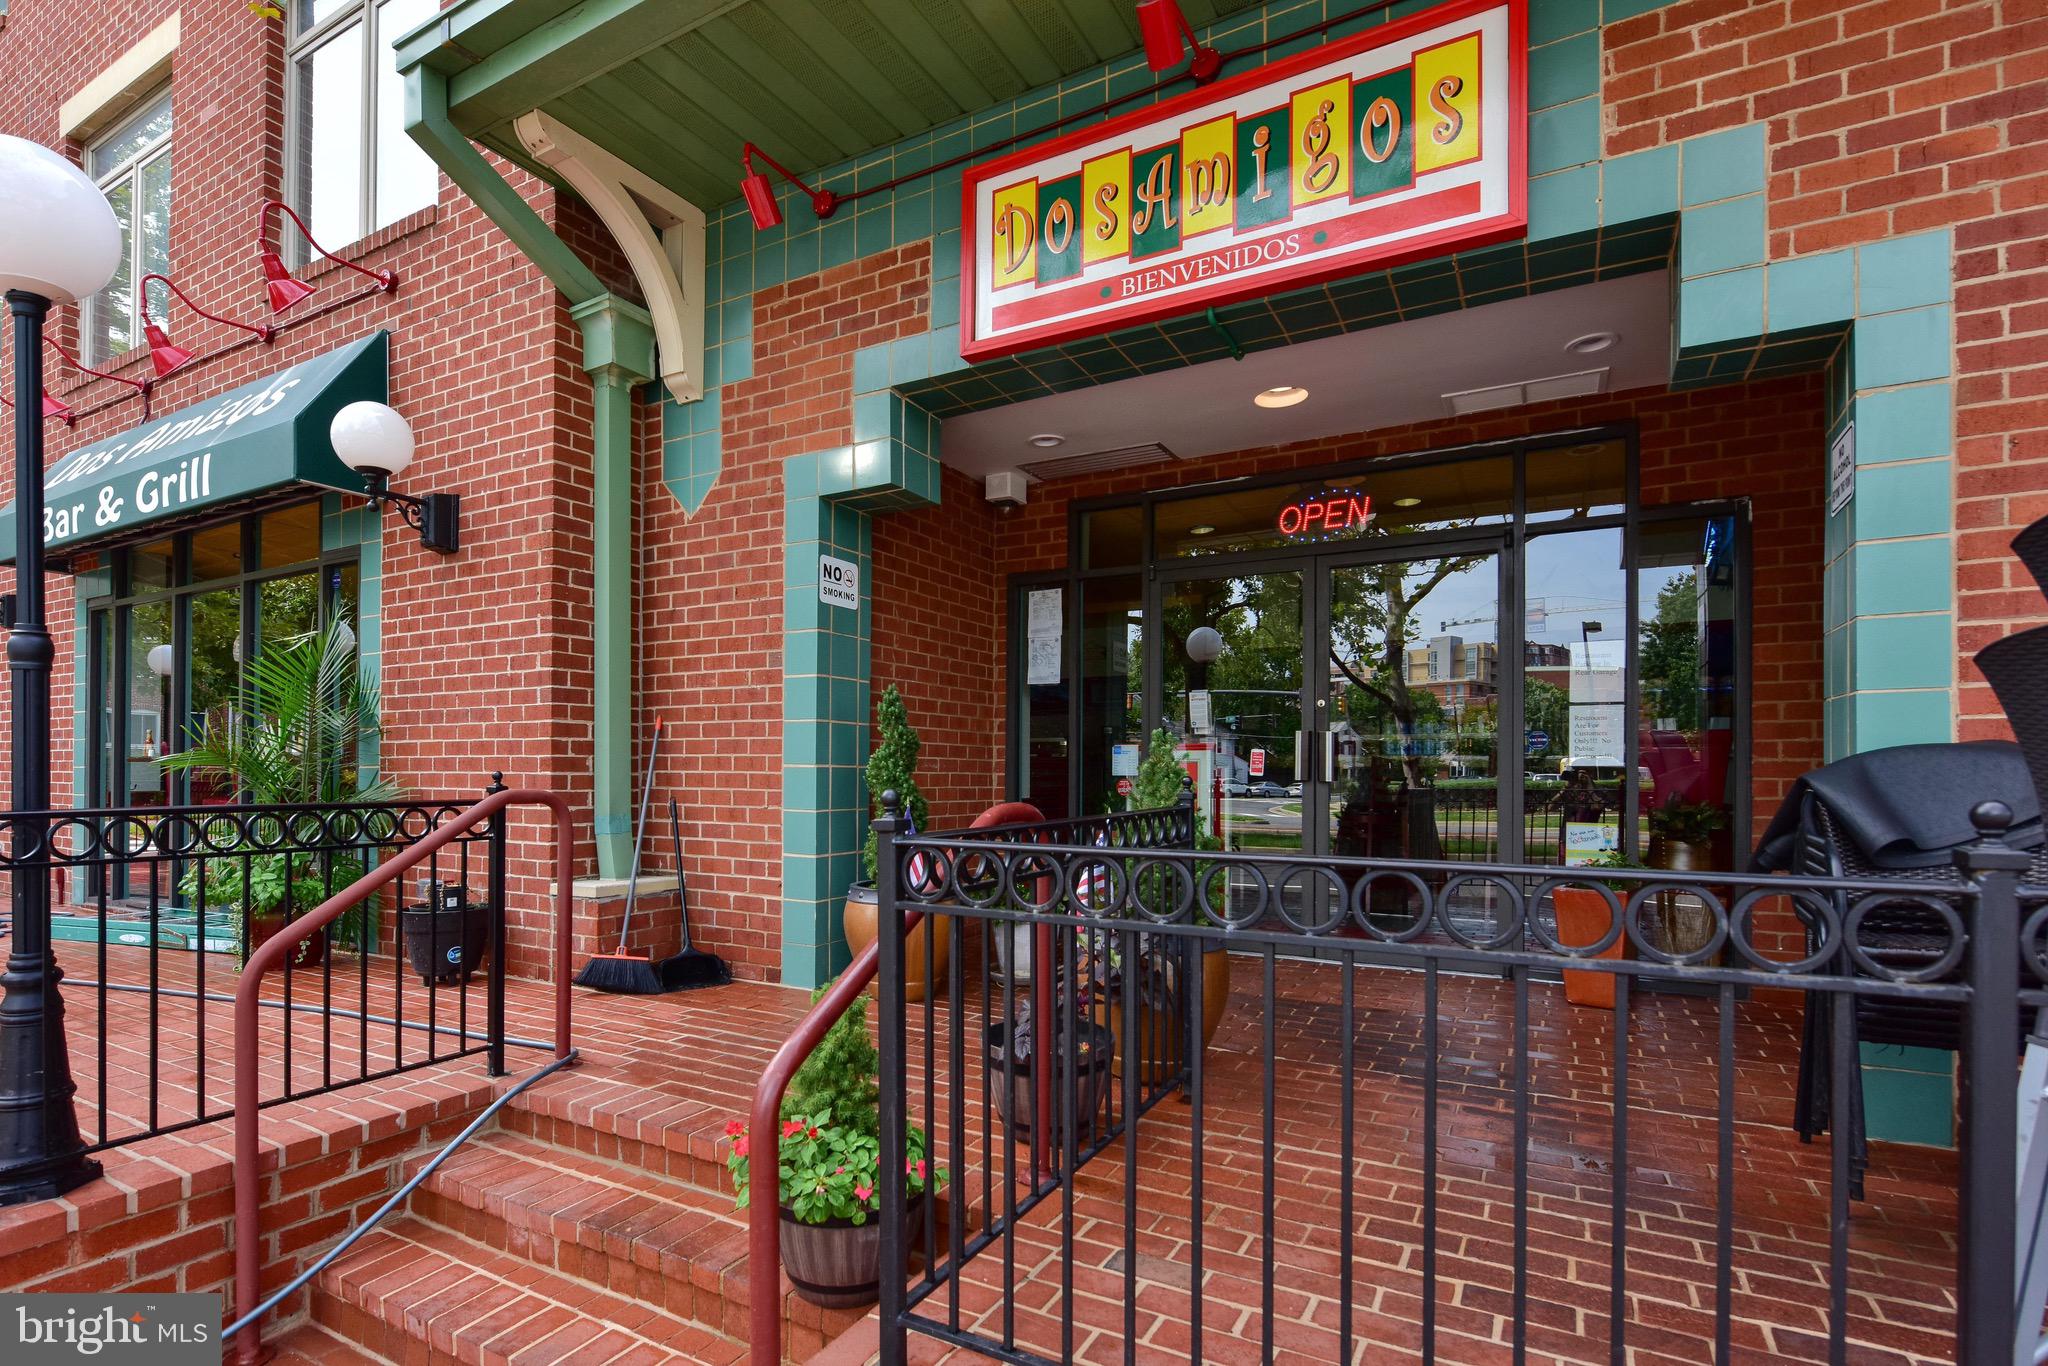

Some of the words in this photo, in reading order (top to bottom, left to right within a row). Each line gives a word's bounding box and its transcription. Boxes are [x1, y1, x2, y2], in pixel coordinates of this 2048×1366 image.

[1120, 234, 1300, 298] BIENVENIDOS
[115, 378, 301, 466] Amigos
[95, 485, 124, 527] &
[136, 453, 211, 514] Grill
[1280, 496, 1370, 534] OPEN
[823, 563, 842, 582] NO
[823, 586, 855, 602] SMOKING
